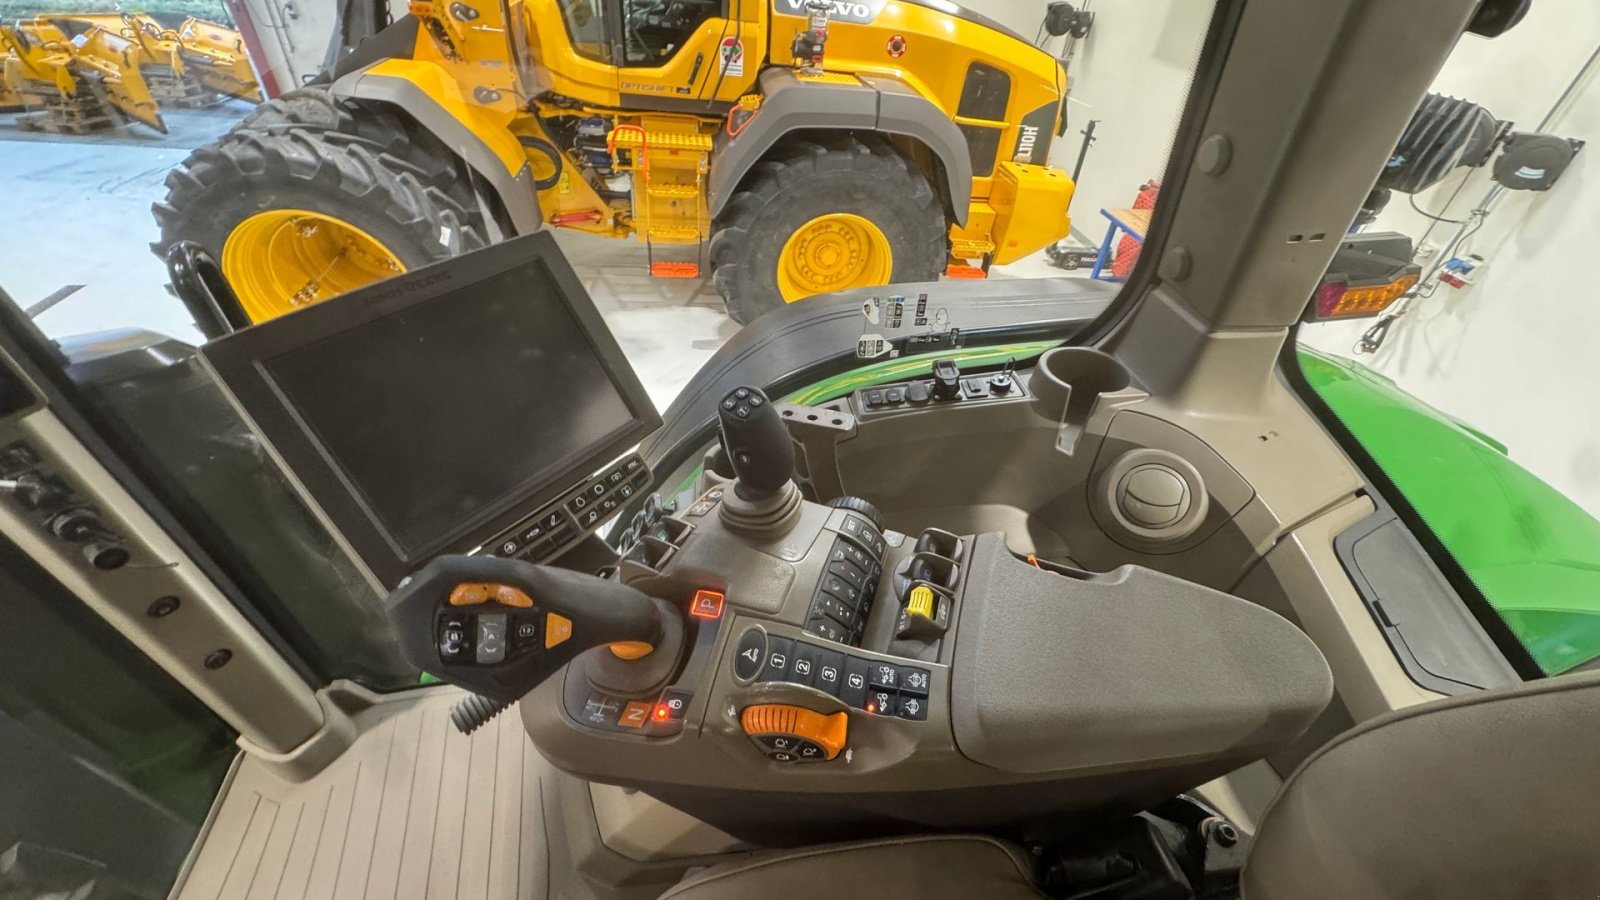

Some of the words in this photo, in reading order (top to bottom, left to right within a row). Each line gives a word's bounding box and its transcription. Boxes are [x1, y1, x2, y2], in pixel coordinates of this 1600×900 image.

[700, 598, 715, 609] P
[751, 648, 759, 663] AUTO
[627, 708, 645, 721] N
